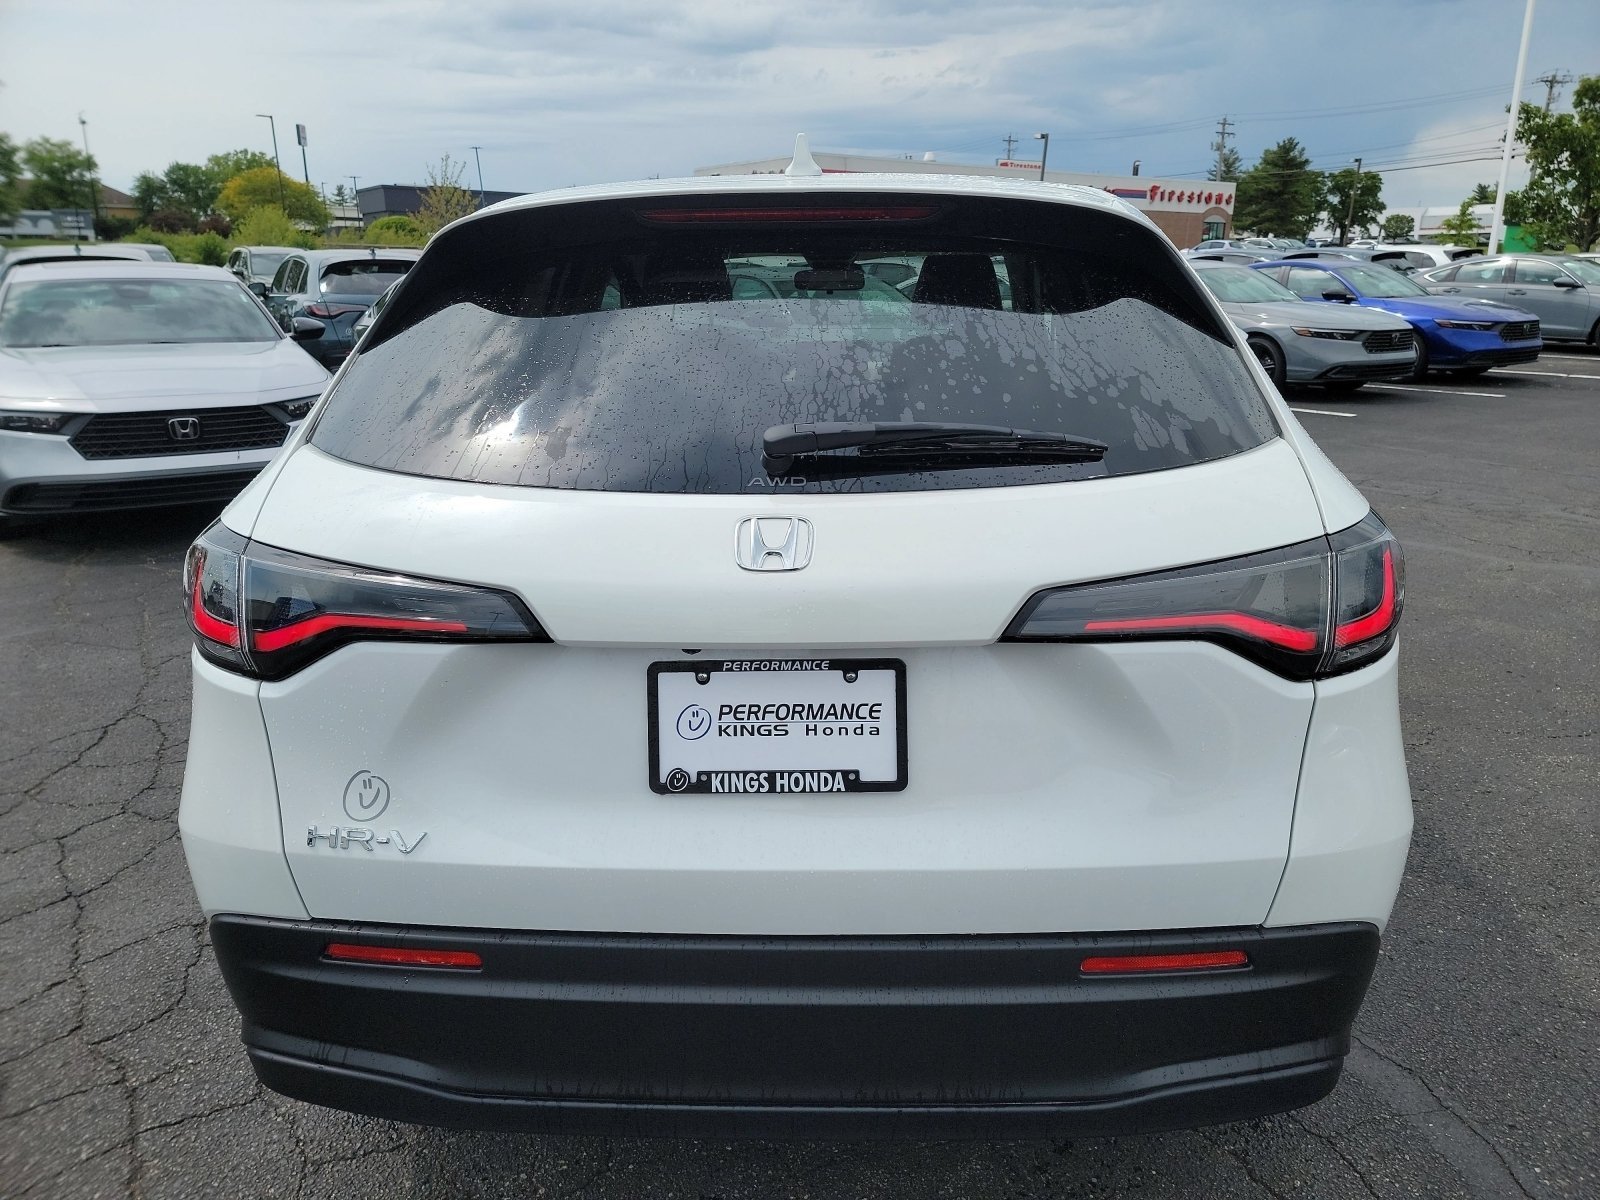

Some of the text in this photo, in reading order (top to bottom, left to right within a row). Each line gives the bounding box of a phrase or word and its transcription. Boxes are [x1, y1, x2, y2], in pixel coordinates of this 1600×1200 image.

[1149, 185, 1233, 205] Firestone
[748, 477, 807, 487] AWD
[723, 660, 830, 671] PERFORMANCE
[718, 703, 882, 721] PERFORMANCE
[718, 723, 880, 737] KINGS Honda
[711, 772, 846, 793] KINGS HONDA
[306, 825, 428, 854] HR-V
